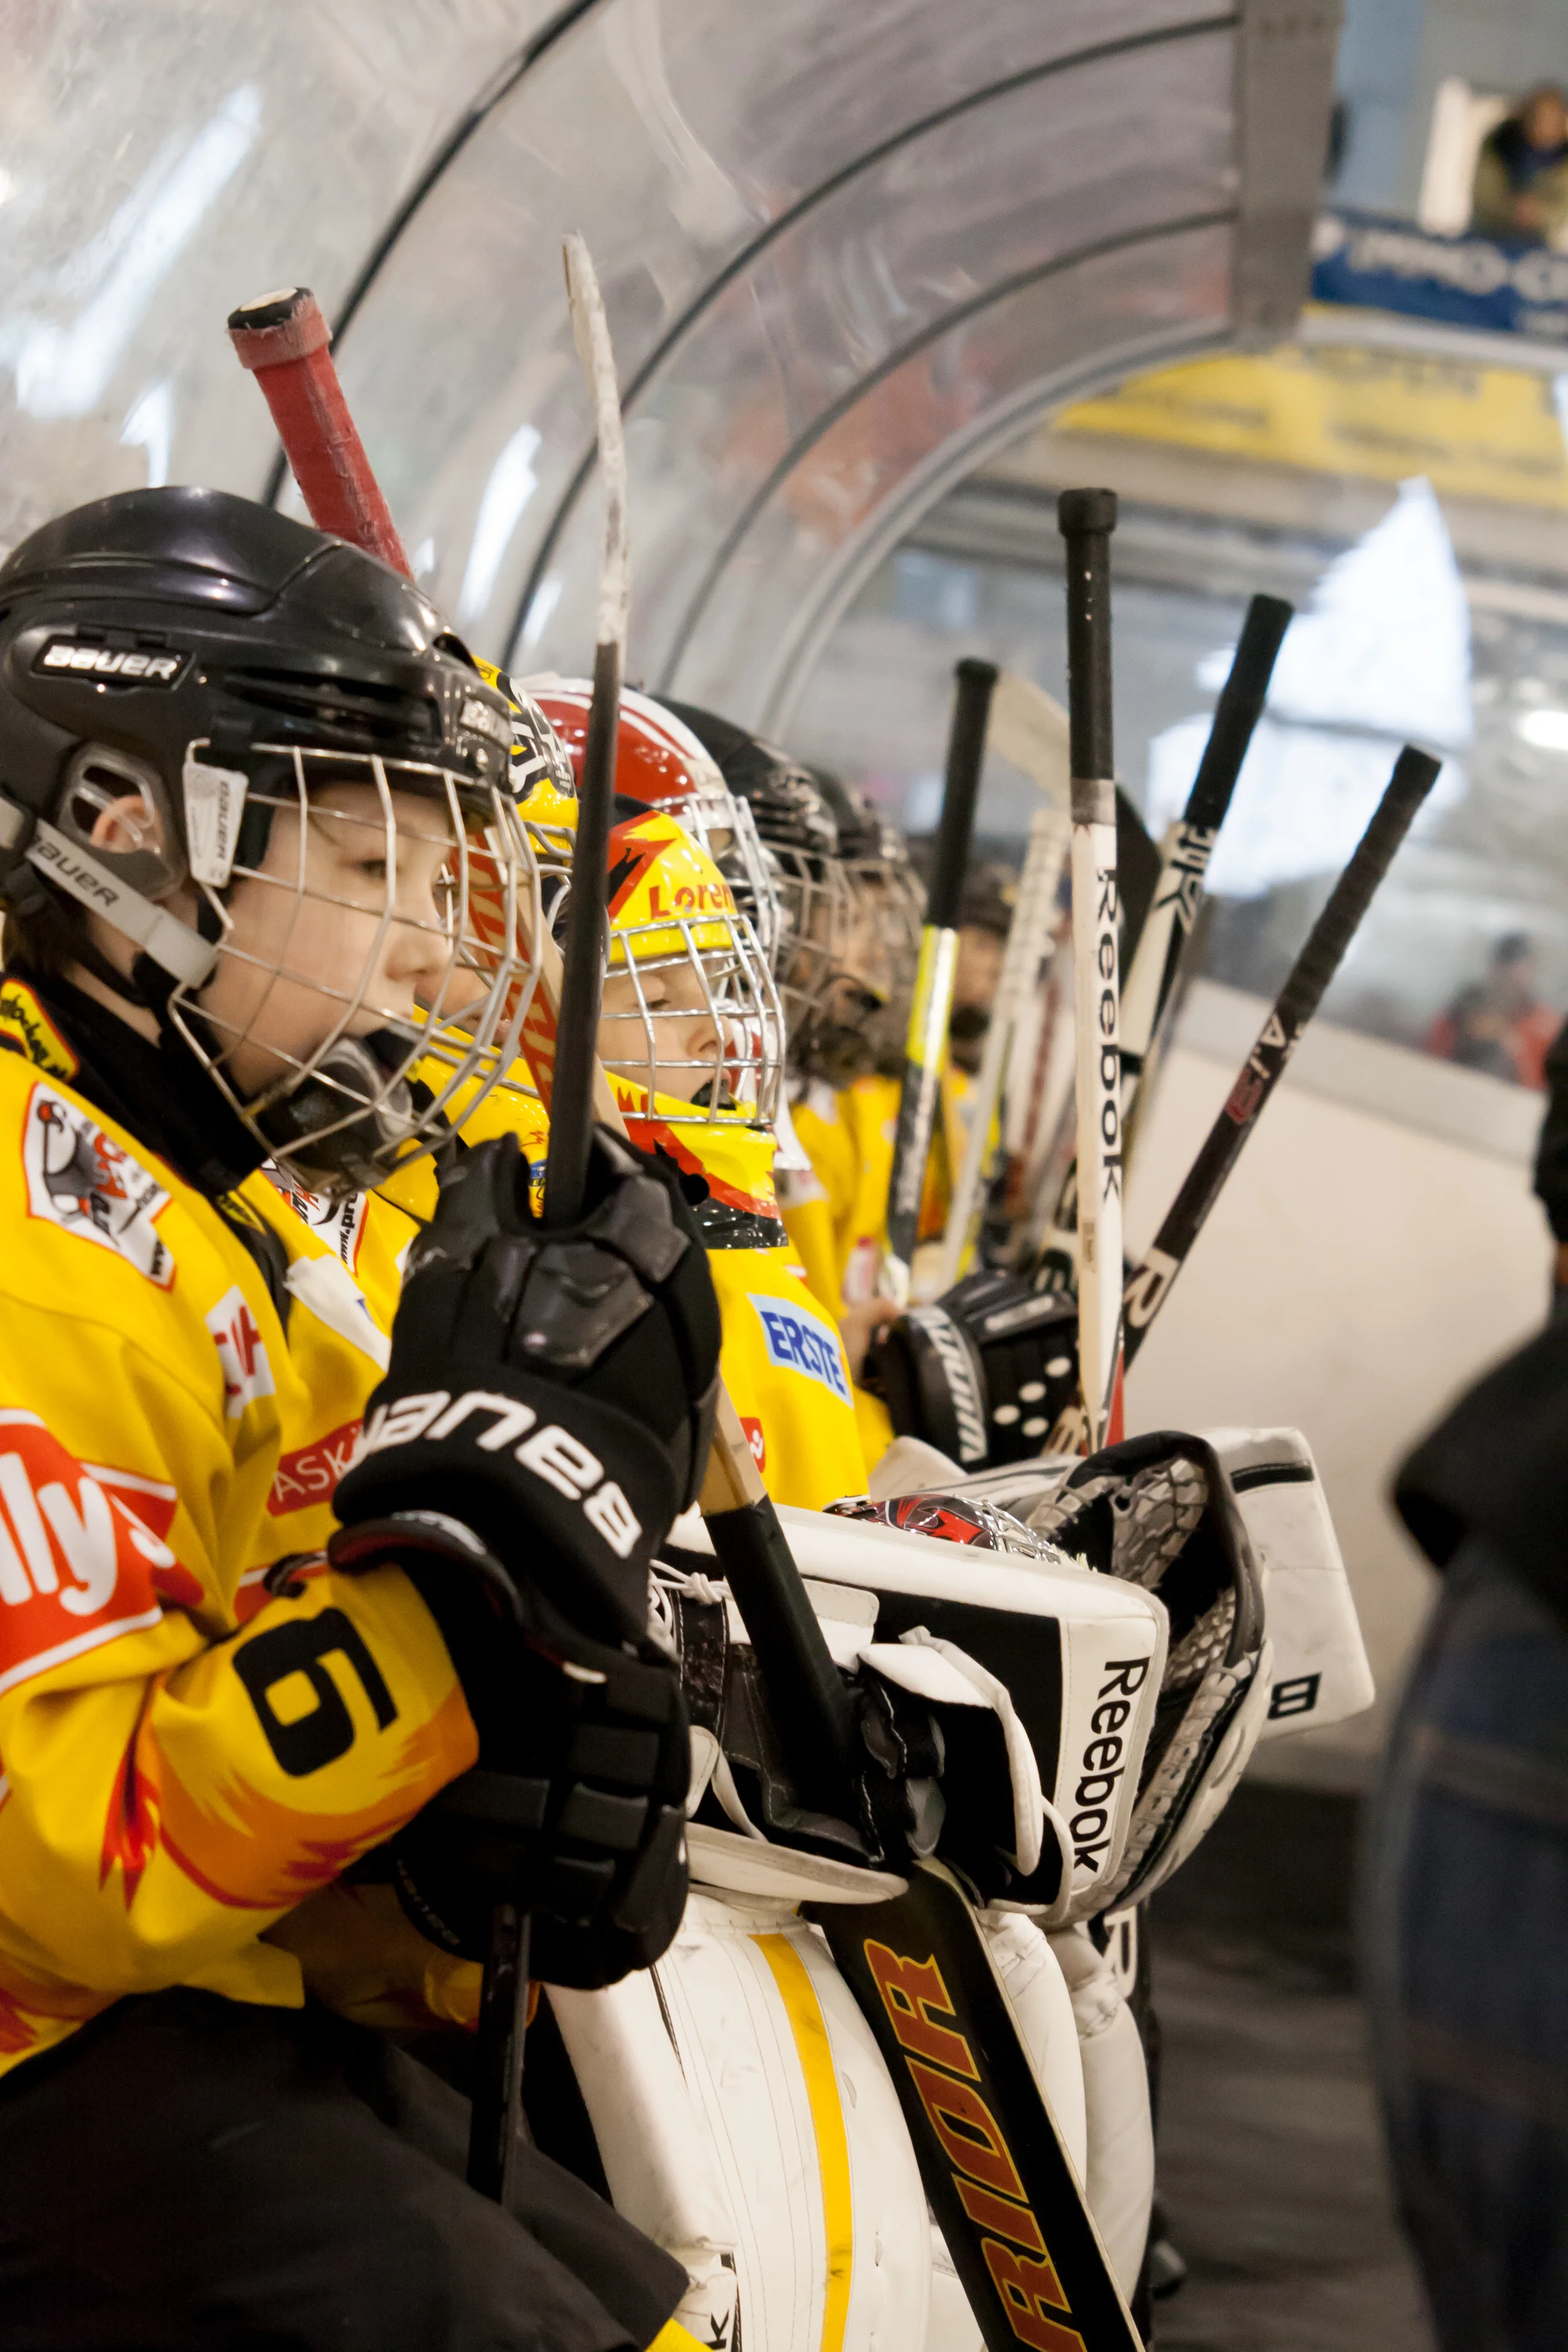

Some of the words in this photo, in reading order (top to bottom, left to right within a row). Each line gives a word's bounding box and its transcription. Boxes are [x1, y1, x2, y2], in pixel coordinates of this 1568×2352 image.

[43, 644, 177, 681] BAUER
[36, 840, 120, 908] AUER
[1097, 869, 1120, 1202] Reebok
[760, 1310, 847, 1396] ERSTE
[1069, 1656, 1152, 1873] Reebok
